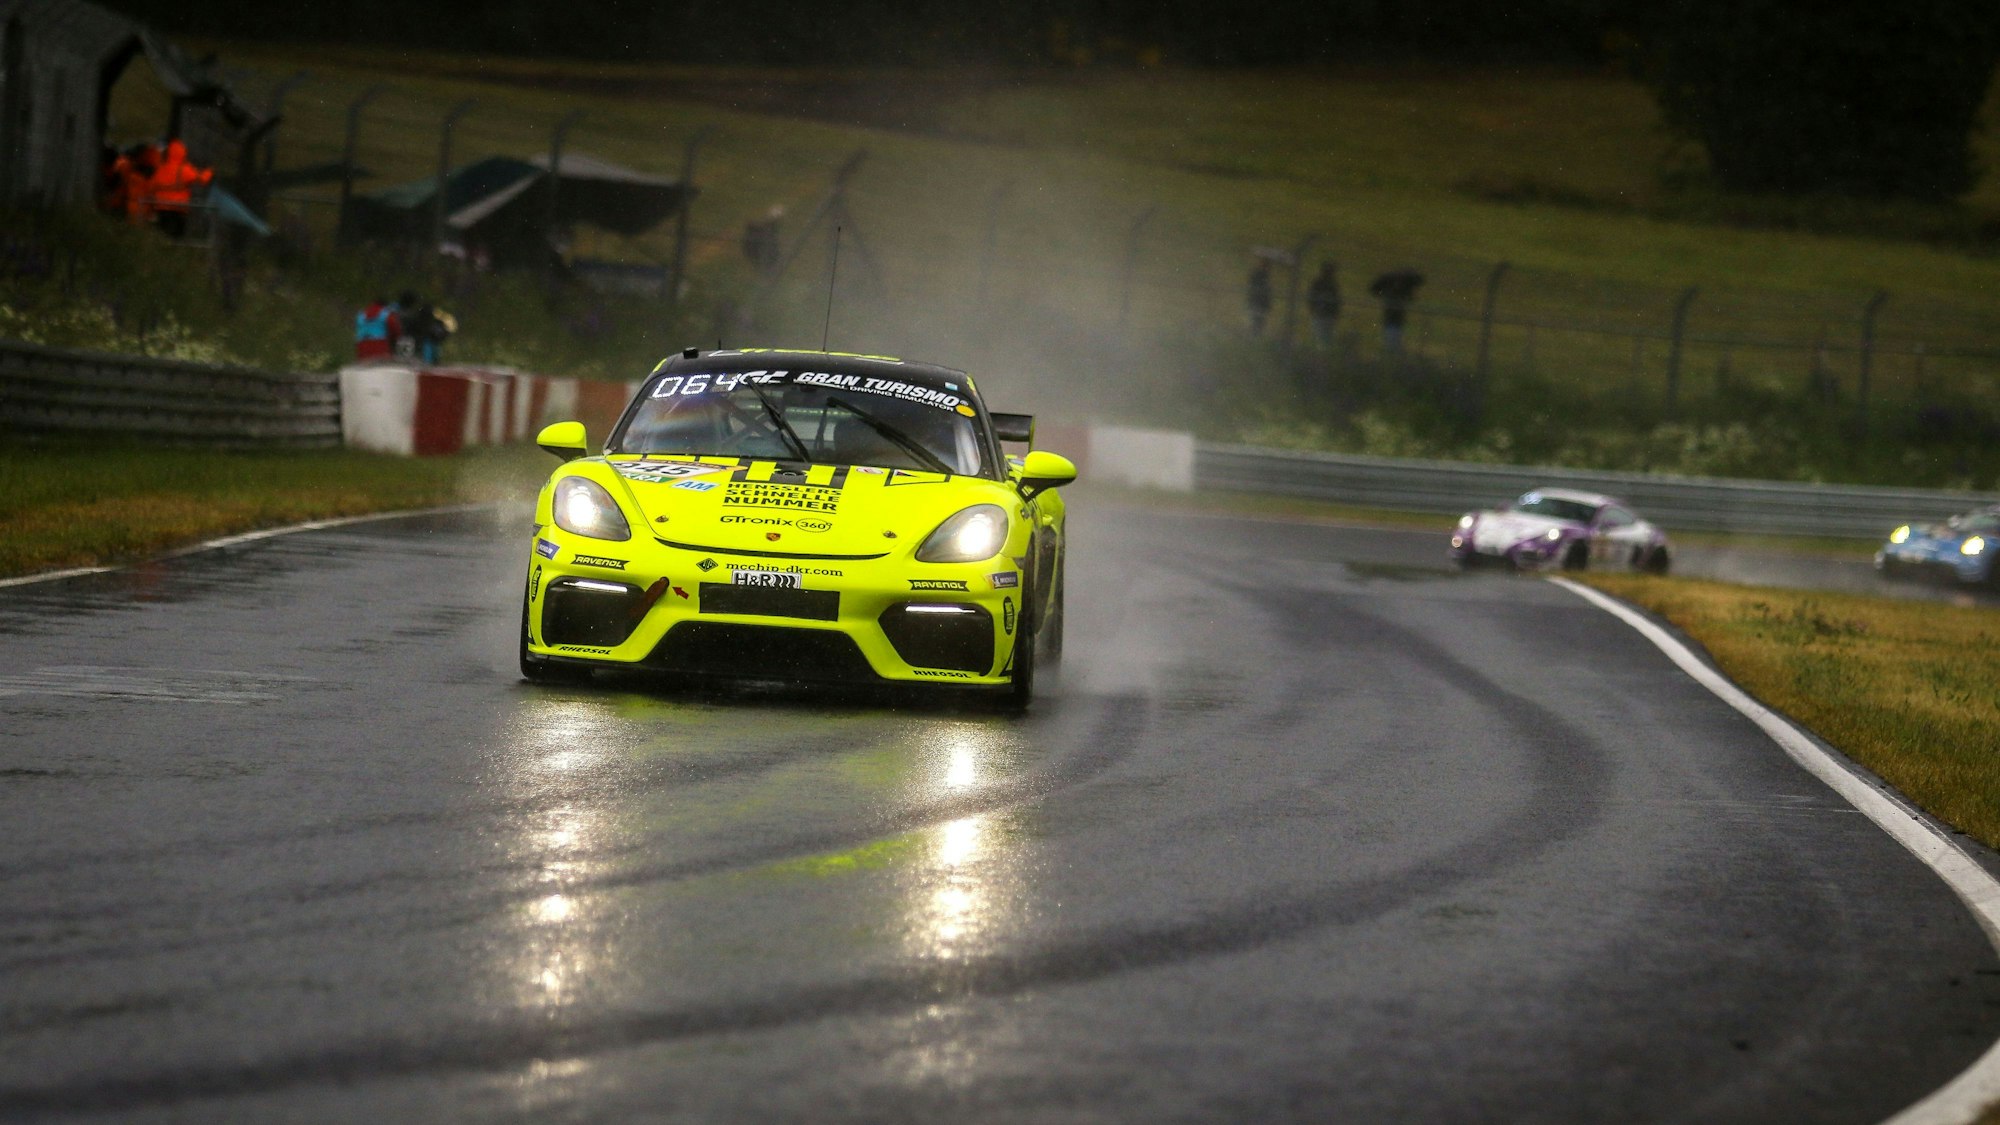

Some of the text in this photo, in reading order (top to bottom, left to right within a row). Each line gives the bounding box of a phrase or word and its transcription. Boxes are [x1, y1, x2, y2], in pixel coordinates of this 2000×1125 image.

[798, 371, 861, 386] GRAN
[850, 386, 955, 412] DRIVING SIMULATOR
[675, 481, 716, 491] AM
[728, 483, 841, 495] HENSSLERS
[726, 489, 840, 502] SCHNELLE
[723, 496, 837, 511] NUMMER
[575, 556, 622, 567] RAVENOL
[914, 581, 964, 589] RAVENOL
[558, 646, 611, 655] RHEOSOL
[913, 670, 971, 678] RHEOSOL
